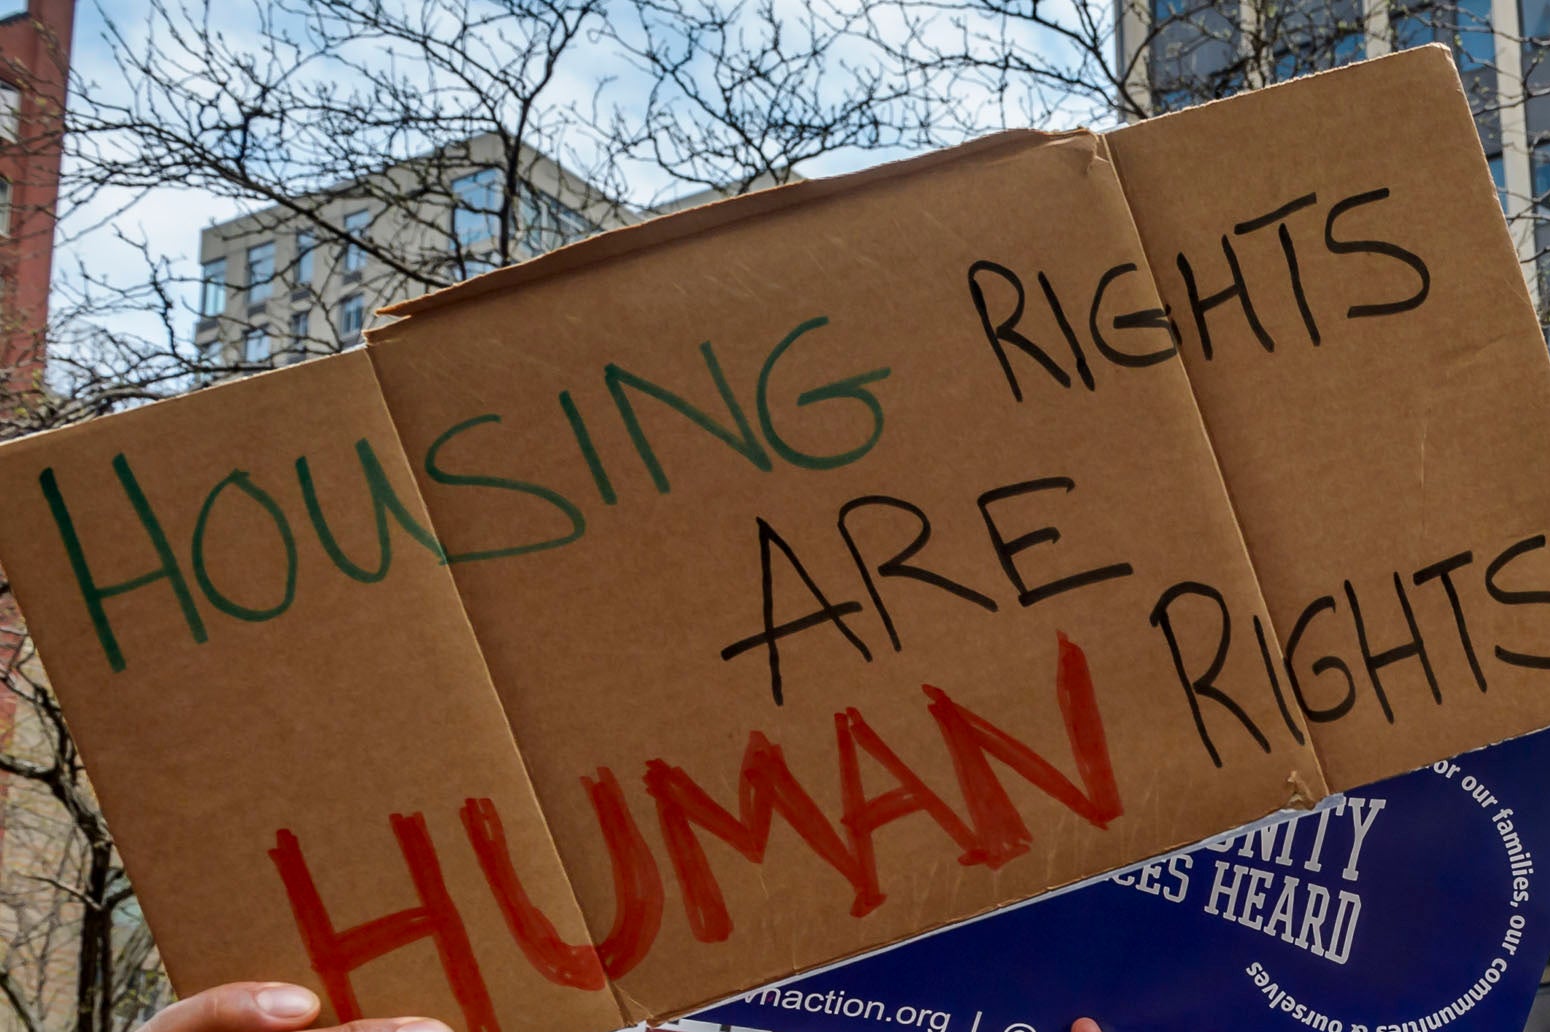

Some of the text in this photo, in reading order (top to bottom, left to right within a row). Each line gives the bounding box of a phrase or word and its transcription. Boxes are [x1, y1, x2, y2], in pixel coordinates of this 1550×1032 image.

[38, 187, 1431, 672] HOUSING RIGHTS
[721, 477, 1133, 705] ARE
[1433, 760, 1461, 779] or
[1461, 776, 1498, 808] our
[1205, 797, 1387, 881] NITY
[1492, 808, 1534, 907] families,
[1203, 860, 1362, 965] HEARD
[1501, 914, 1526, 956] our
